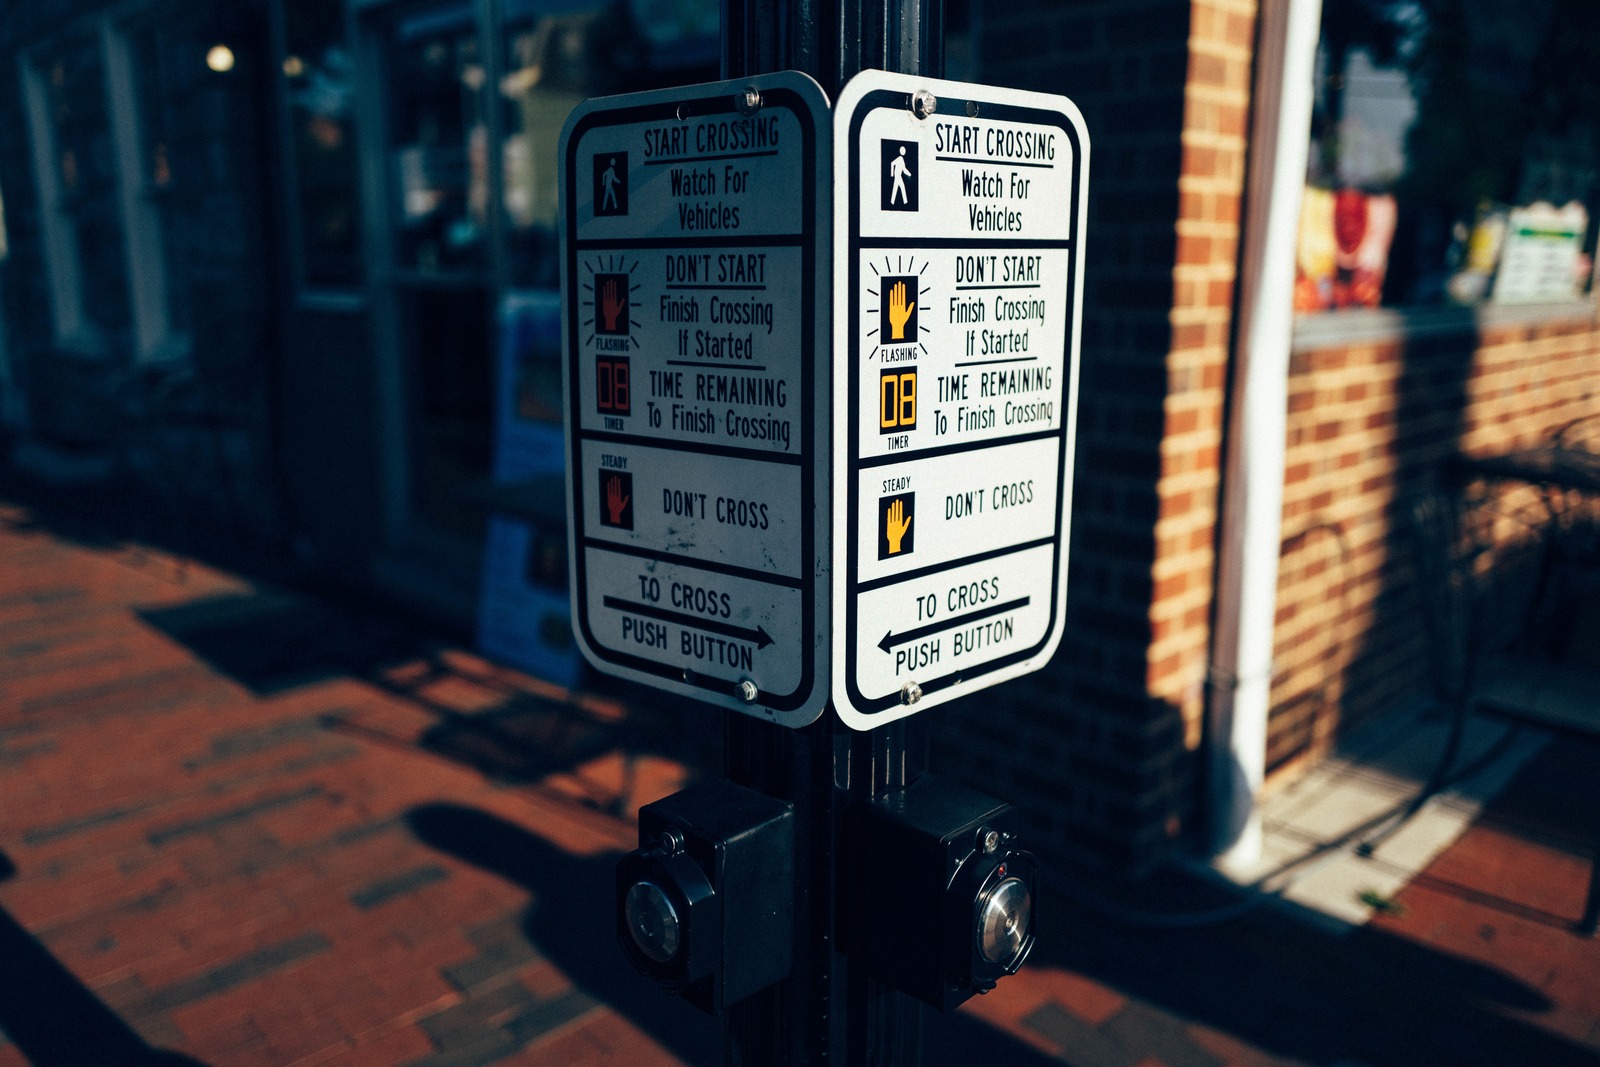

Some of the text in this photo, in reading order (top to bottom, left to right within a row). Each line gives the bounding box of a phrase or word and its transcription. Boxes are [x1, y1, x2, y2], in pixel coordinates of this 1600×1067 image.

[644, 116, 779, 157] START CROSSING
[936, 123, 1055, 161] START CROSSING
[671, 165, 749, 197] Watch For
[962, 169, 1030, 200] Watch For
[679, 201, 740, 230] Vehicles
[969, 203, 1022, 232] Vehicles
[666, 254, 766, 283] DON'T START
[956, 256, 1041, 283] DON'T START
[660, 295, 773, 335] Finish Crossing
[950, 294, 1045, 327] Finish Crossing
[596, 338, 630, 352] FLASHING
[678, 329, 753, 360] If Started
[881, 347, 918, 363] FLASHING
[966, 328, 1029, 357] If Started
[597, 361, 630, 410] 08
[649, 370, 787, 408] TIME REMAINING
[881, 373, 917, 428] 08
[937, 366, 1052, 403] TIME REMAINING
[604, 416, 624, 431] TIMER
[647, 402, 790, 451] To Finish Crossing
[934, 397, 1053, 436] To Finish Crossing
[887, 435, 909, 451] TIMER
[601, 454, 628, 469] STEADY
[882, 476, 911, 494] STEADY
[945, 480, 1034, 521] DON'T CROSS
[663, 488, 769, 530] DON'T CROSS
[638, 574, 731, 619] TO CROSS
[916, 577, 999, 621] TO CROSS
[622, 616, 753, 672] PUSH BUTTON
[895, 617, 1014, 676] PUSH BUTTON
